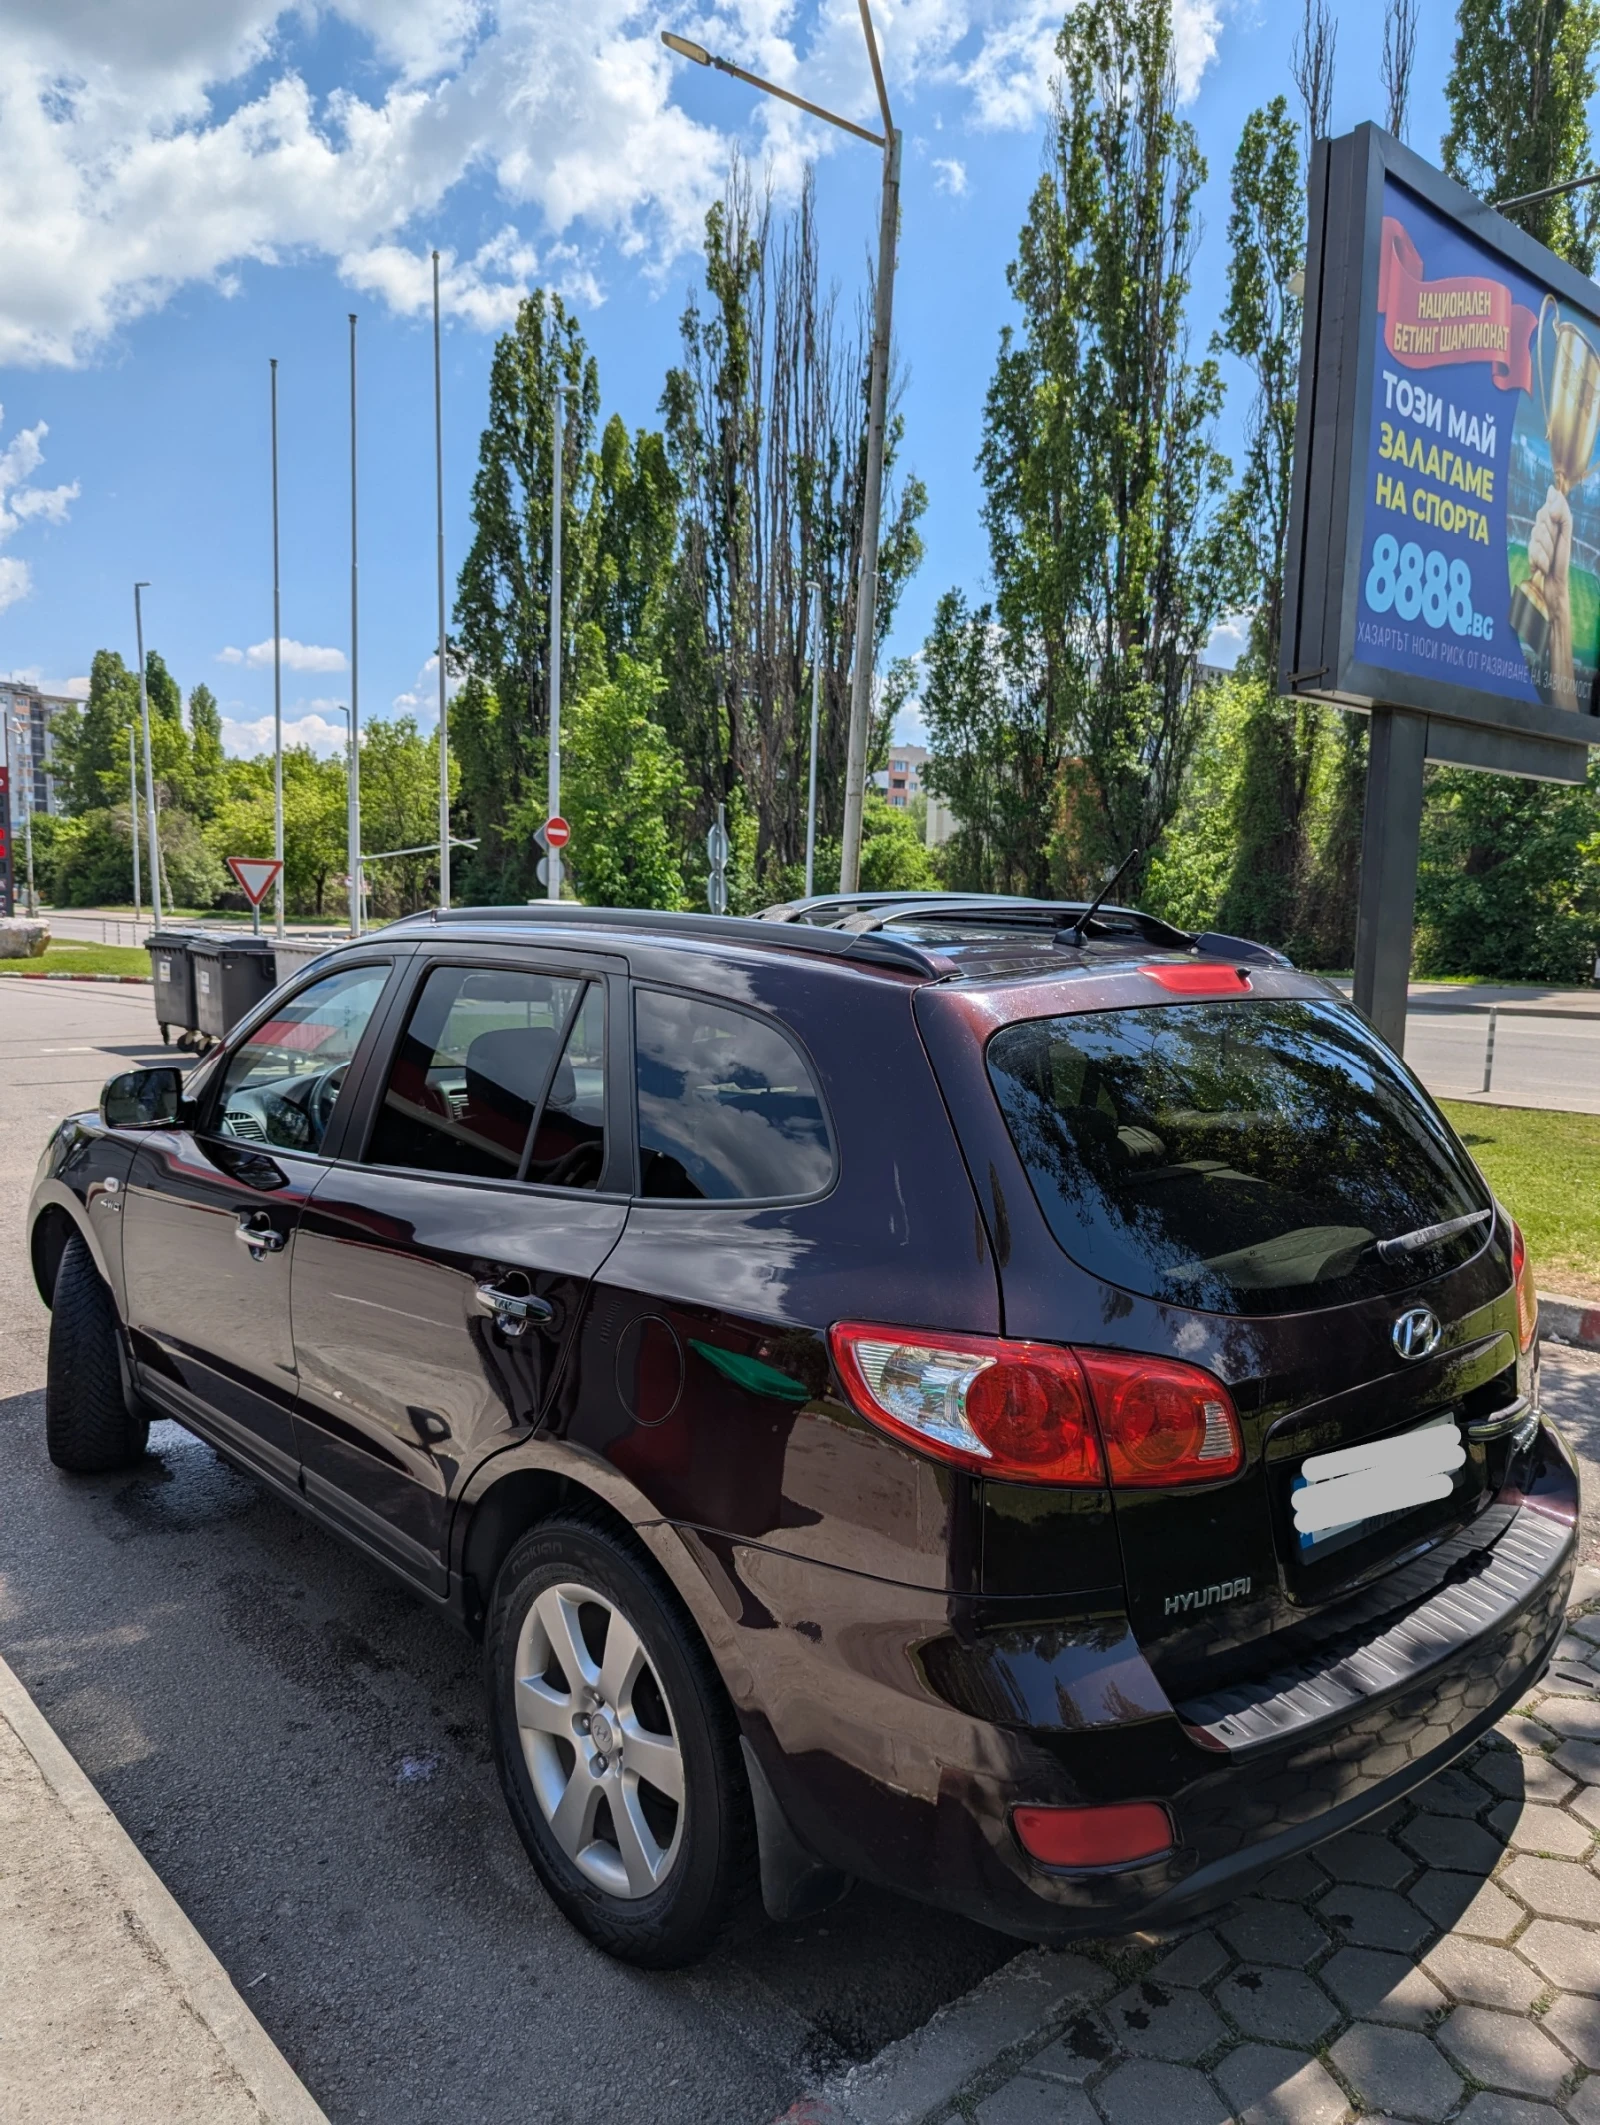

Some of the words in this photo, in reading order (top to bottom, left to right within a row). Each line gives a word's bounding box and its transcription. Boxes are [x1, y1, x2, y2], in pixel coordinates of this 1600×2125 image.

[1418, 291, 1492, 322] НАЦИОНАЛЕН
[1394, 322, 1437, 354] БЕТИНГ
[1440, 322, 1510, 352] ШАМПИОНАТ
[1383, 370, 1443, 433] ТОЗИ
[1448, 404, 1497, 458] МАЙ
[1378, 421, 1495, 503] ЗАЛАГАМЕ
[1375, 472, 1407, 515] НА
[1412, 488, 1490, 546] СПОРТА
[1357, 621, 1409, 652] ХАЗАРТЪТ
[1412, 635, 1438, 660] НОСИ
[1440, 643, 1465, 666] РИСК
[1467, 650, 1479, 669] ОТ
[1481, 654, 1529, 684] РАЗВИВАНЕ
[1530, 668, 1541, 686] НА
[100, 1198, 121, 1212] 4WD
[1164, 1576, 1251, 1616] HYUNDAI
